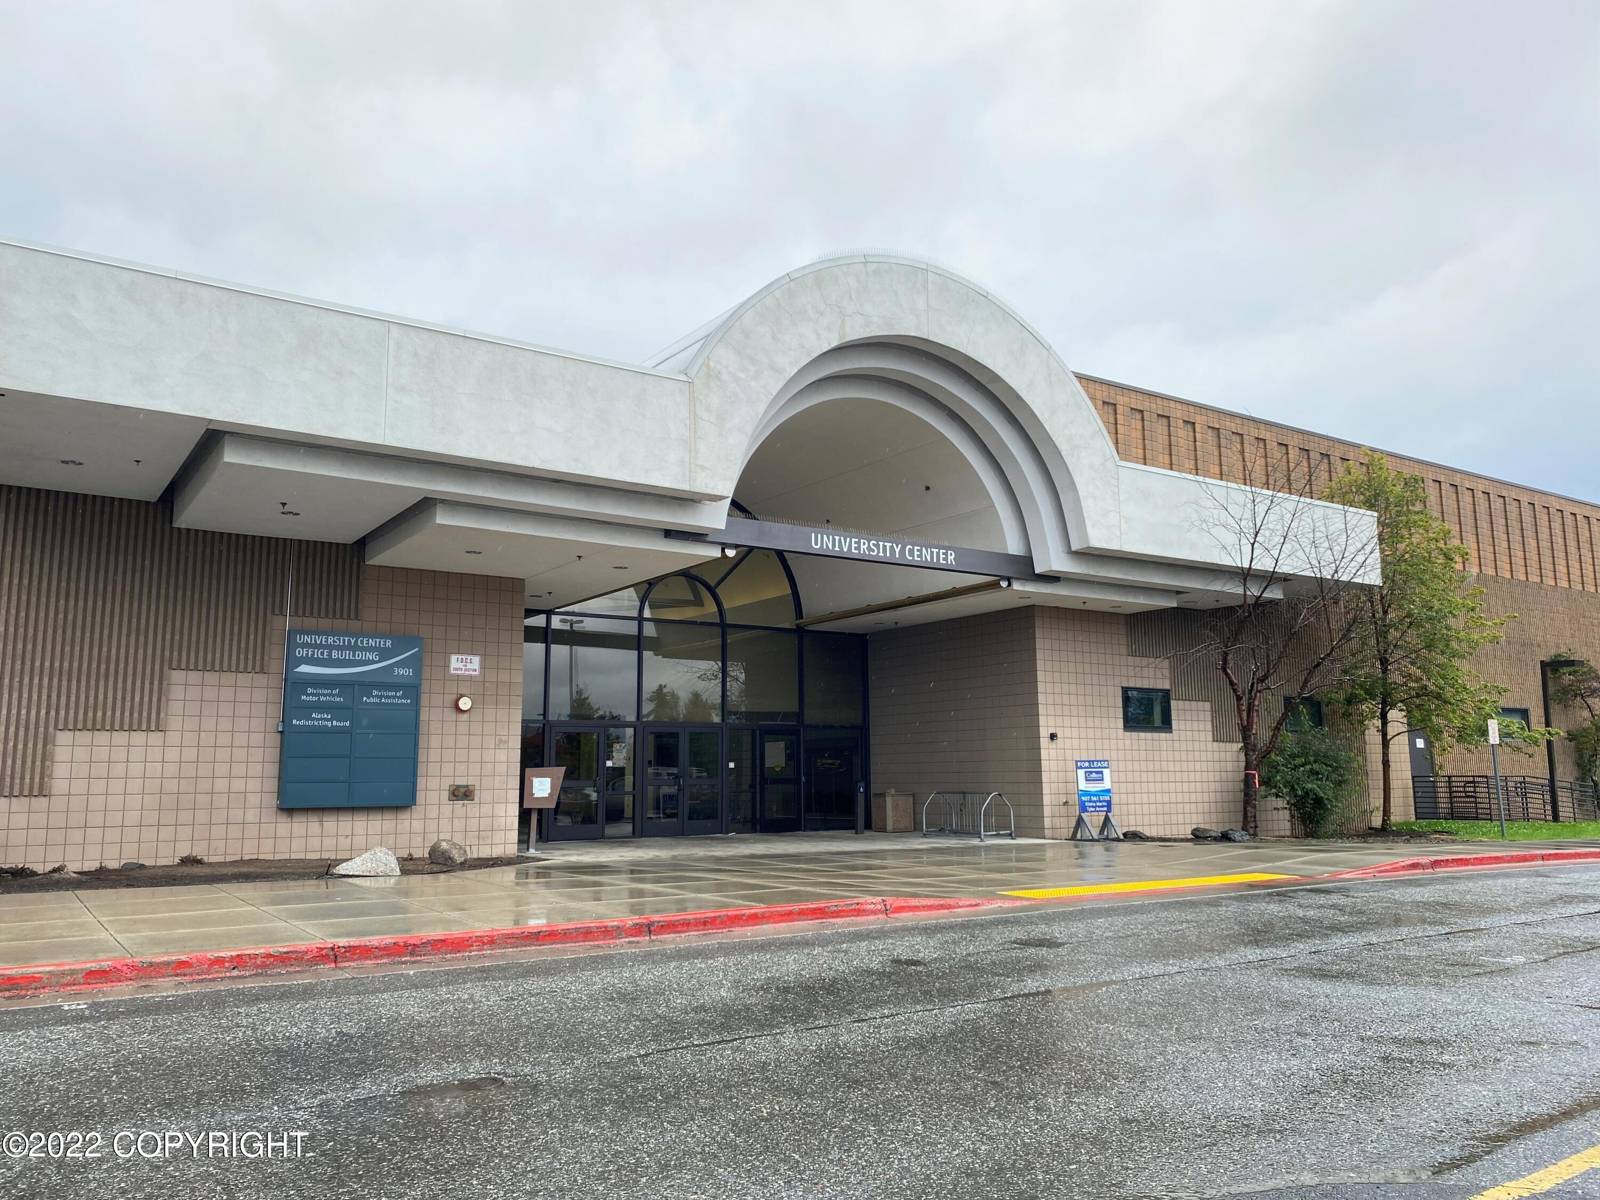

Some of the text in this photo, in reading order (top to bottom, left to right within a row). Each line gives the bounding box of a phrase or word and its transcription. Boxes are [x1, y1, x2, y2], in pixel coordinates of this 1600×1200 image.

[811, 532, 956, 565] UNIVERSITY CENTER
[296, 634, 392, 648] UNIVERSITY CENTER
[295, 648, 380, 661] OFFICE BUILDING
[392, 667, 413, 676] 3901
[292, 719, 332, 727] Redistricting
